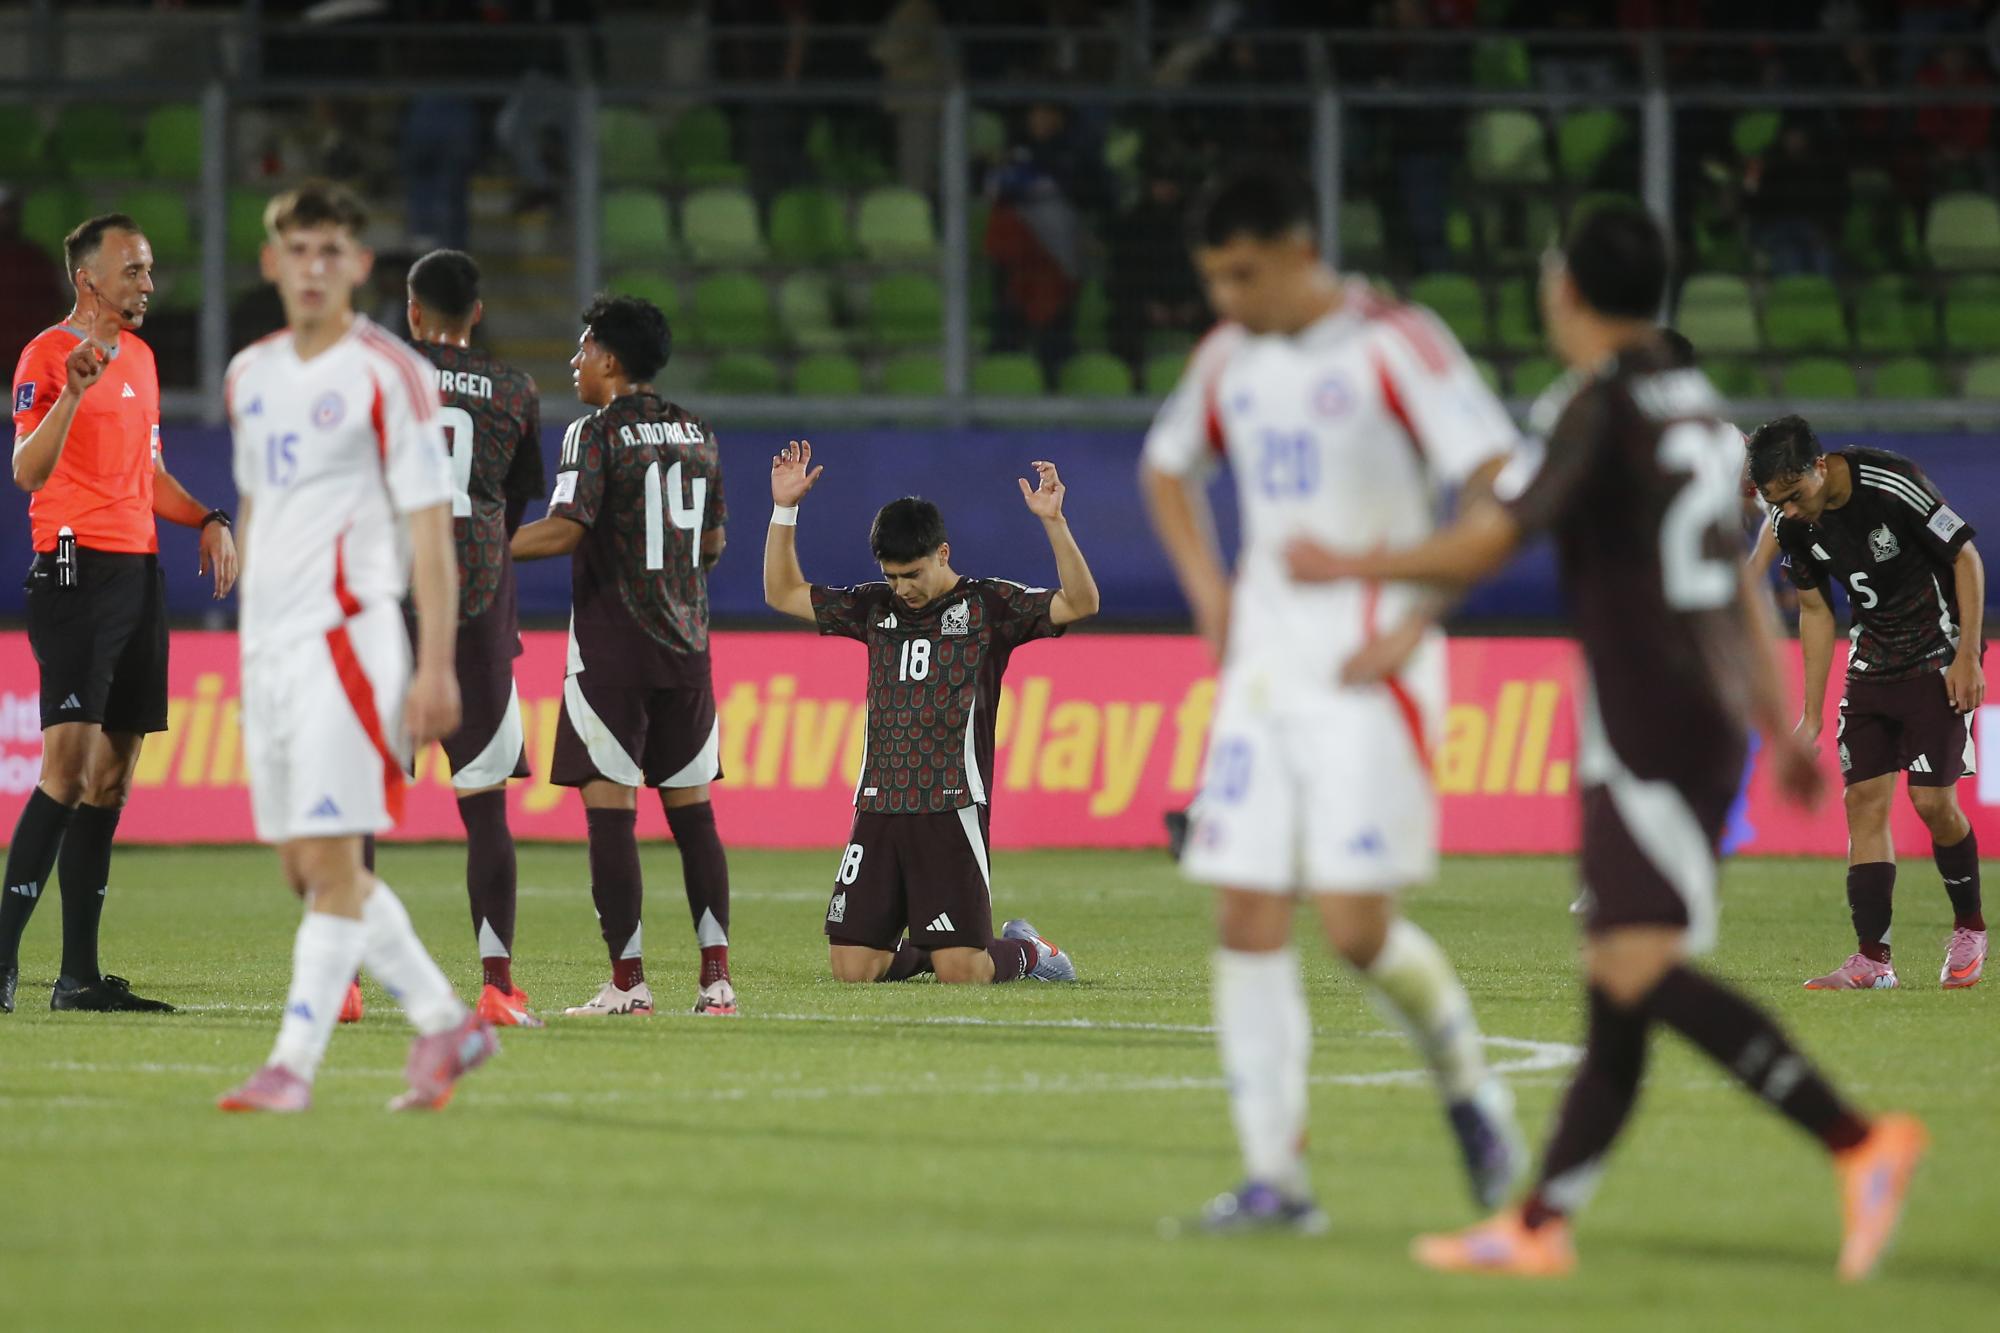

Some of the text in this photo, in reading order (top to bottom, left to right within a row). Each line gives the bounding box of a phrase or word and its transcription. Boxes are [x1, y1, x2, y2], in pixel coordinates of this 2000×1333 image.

[619, 421, 705, 447] A.MORALES
[266, 431, 300, 487] 15
[1256, 427, 1323, 500] 20
[645, 460, 707, 570] 14
[1849, 571, 1879, 609] 5
[899, 638, 932, 681] 18
